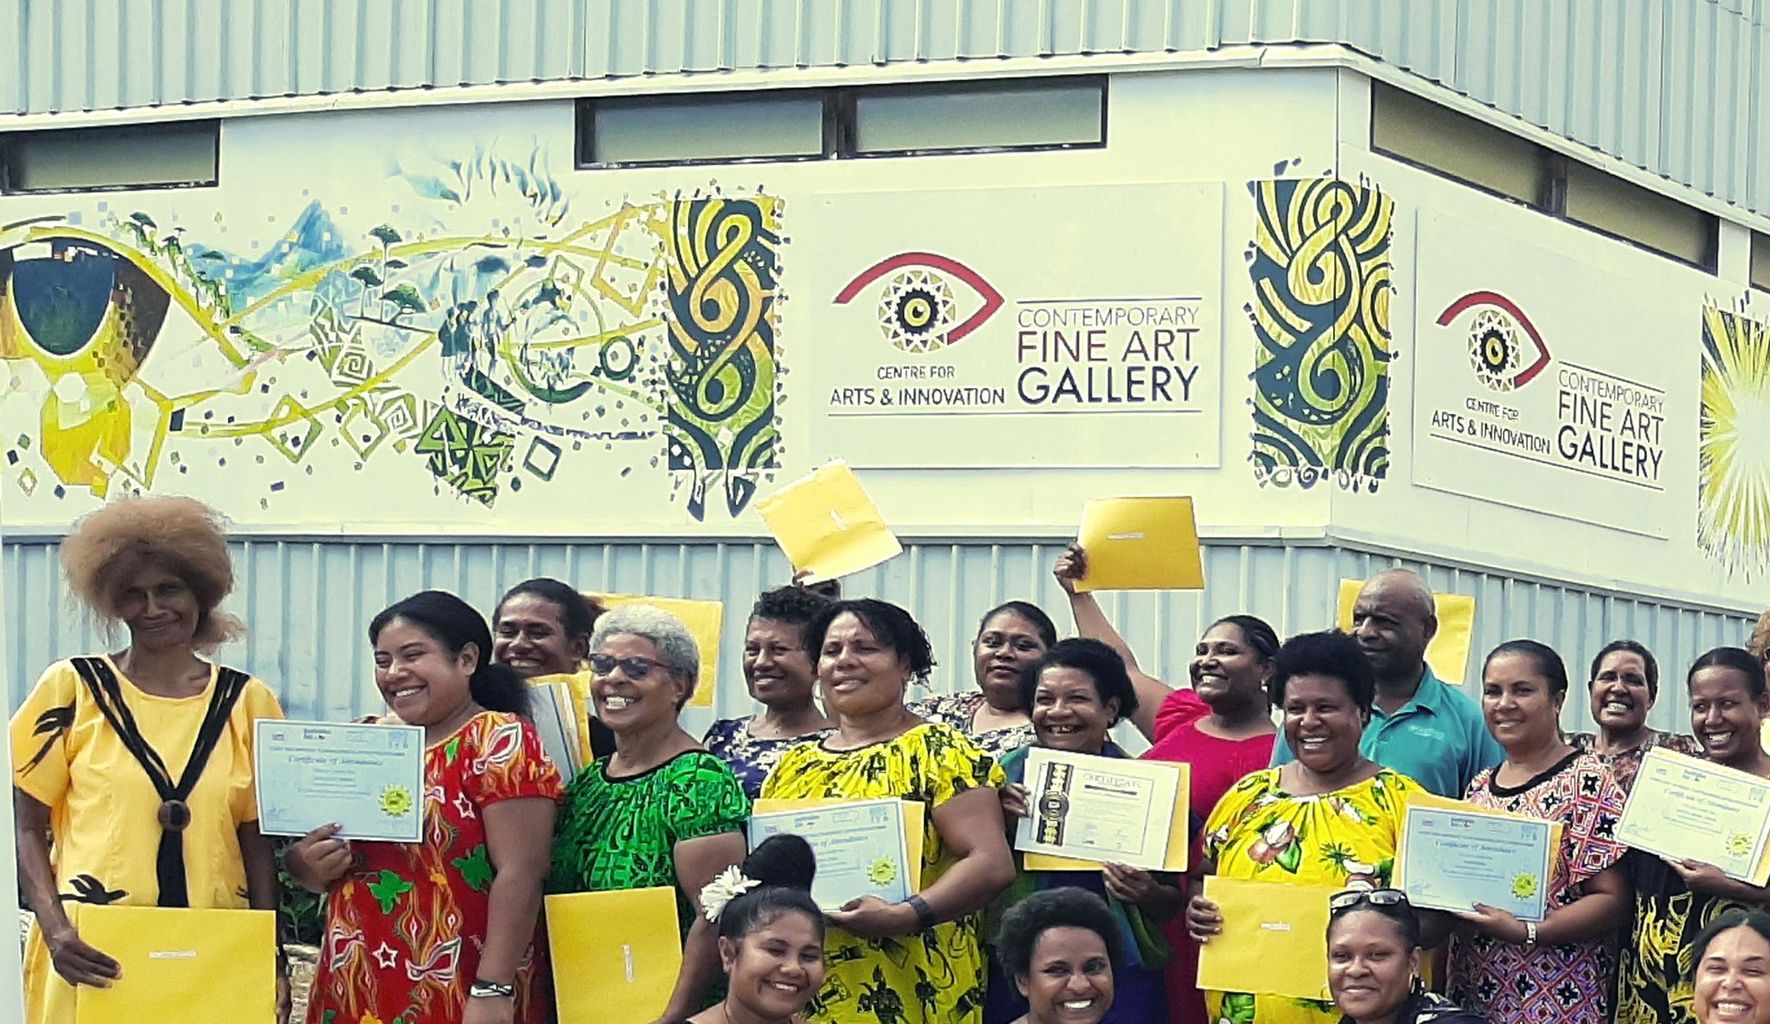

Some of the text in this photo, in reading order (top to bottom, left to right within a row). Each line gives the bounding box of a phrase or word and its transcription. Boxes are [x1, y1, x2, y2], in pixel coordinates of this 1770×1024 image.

[1018, 306, 1199, 328] CONTEMPORARY
[1018, 328, 1200, 363] FINE ART
[877, 365, 955, 380] CENTRE FOR
[1017, 365, 1199, 405] GALLERY
[1559, 369, 1663, 413] CONTEMPORARY
[830, 387, 1005, 406] ARTS & INNOVATION
[1466, 397, 1500, 418] CENTRE
[1431, 409, 1551, 454] ARTS & INNOVATION
[1559, 389, 1664, 445] FINE ART
[1558, 425, 1663, 480] GALLERY
